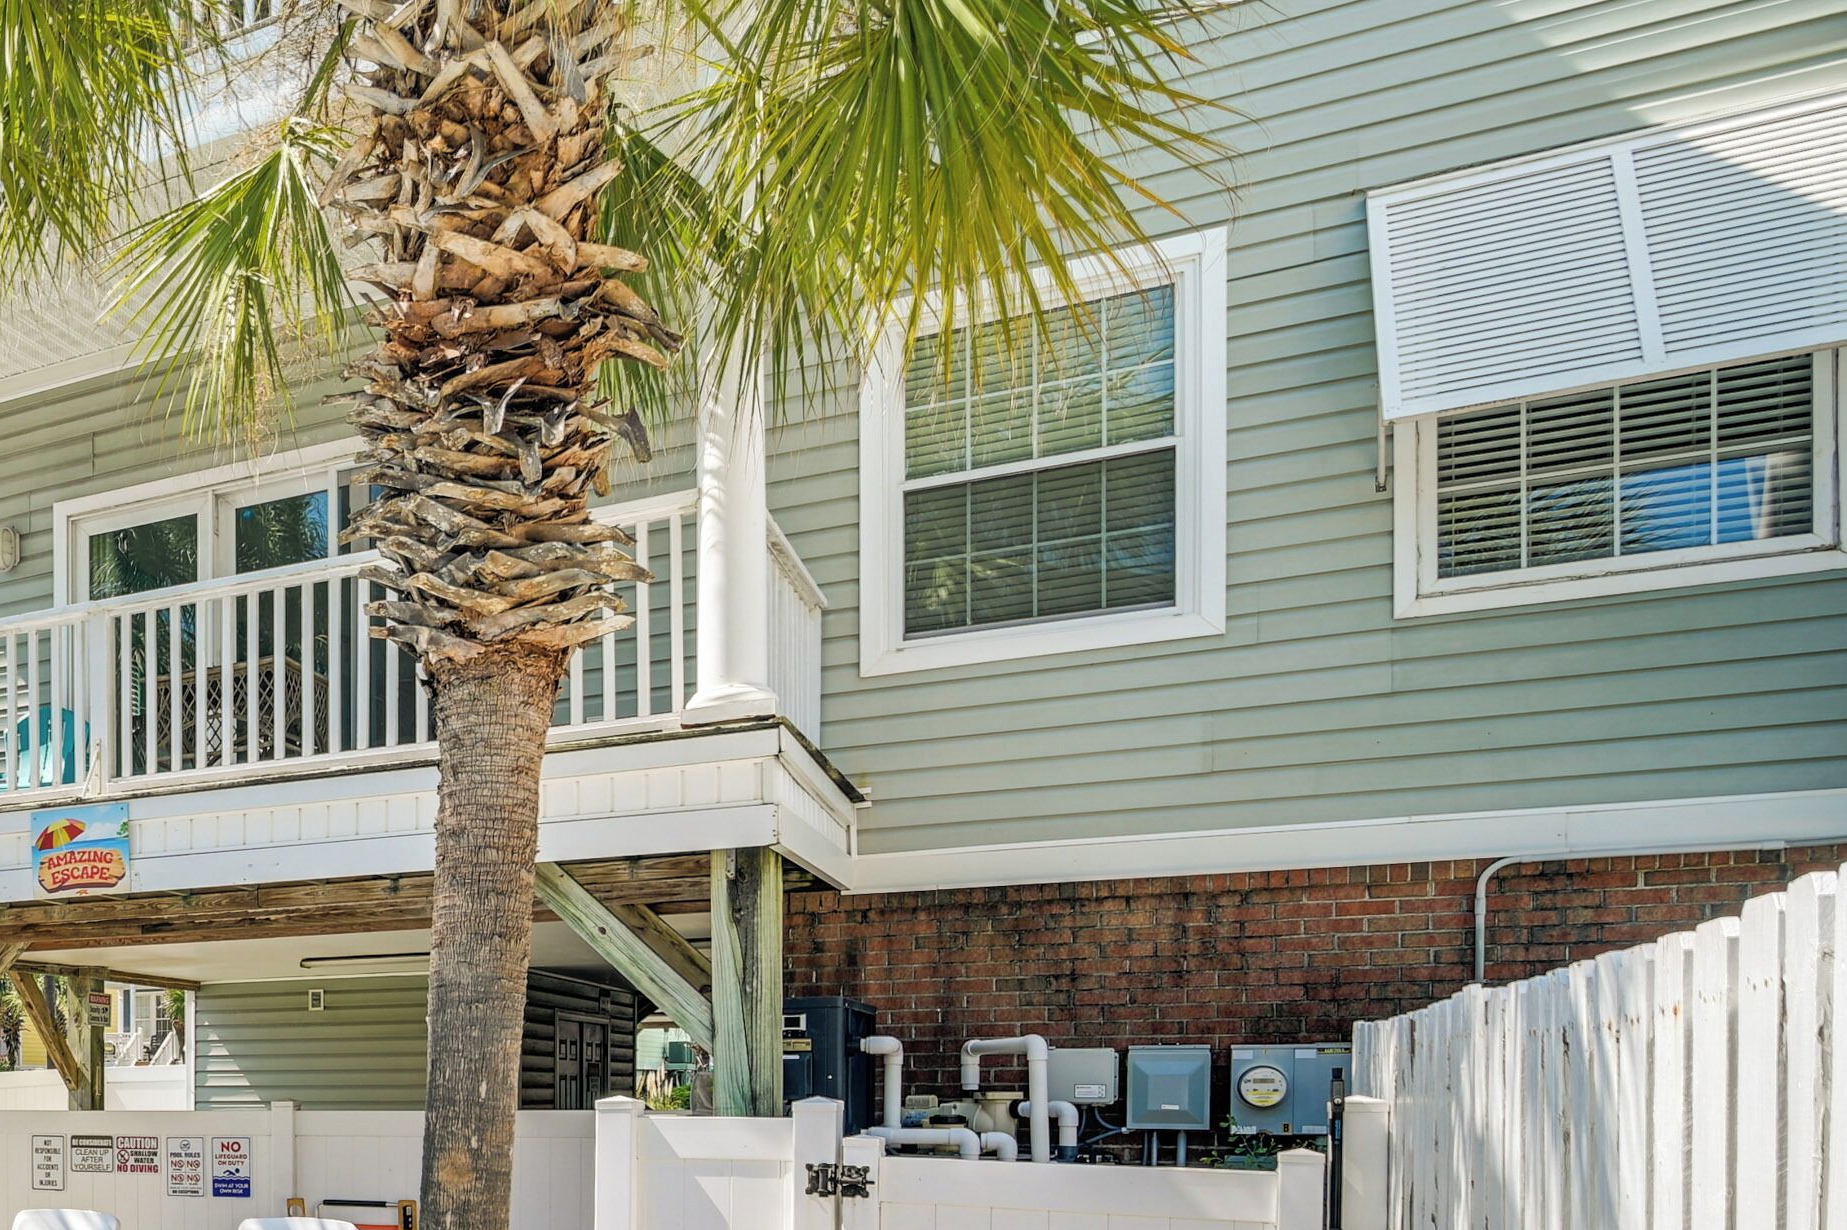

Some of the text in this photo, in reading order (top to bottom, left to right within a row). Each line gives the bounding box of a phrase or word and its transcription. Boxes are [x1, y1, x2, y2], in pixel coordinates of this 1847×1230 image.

[48, 850, 113, 870] AMAZING
[51, 865, 110, 885] ESCAPE
[117, 1137, 157, 1149] CAUTION
[221, 1141, 241, 1153] NO
[75, 1148, 97, 1156] CLEAN
[117, 1164, 159, 1173] NO DIVING
